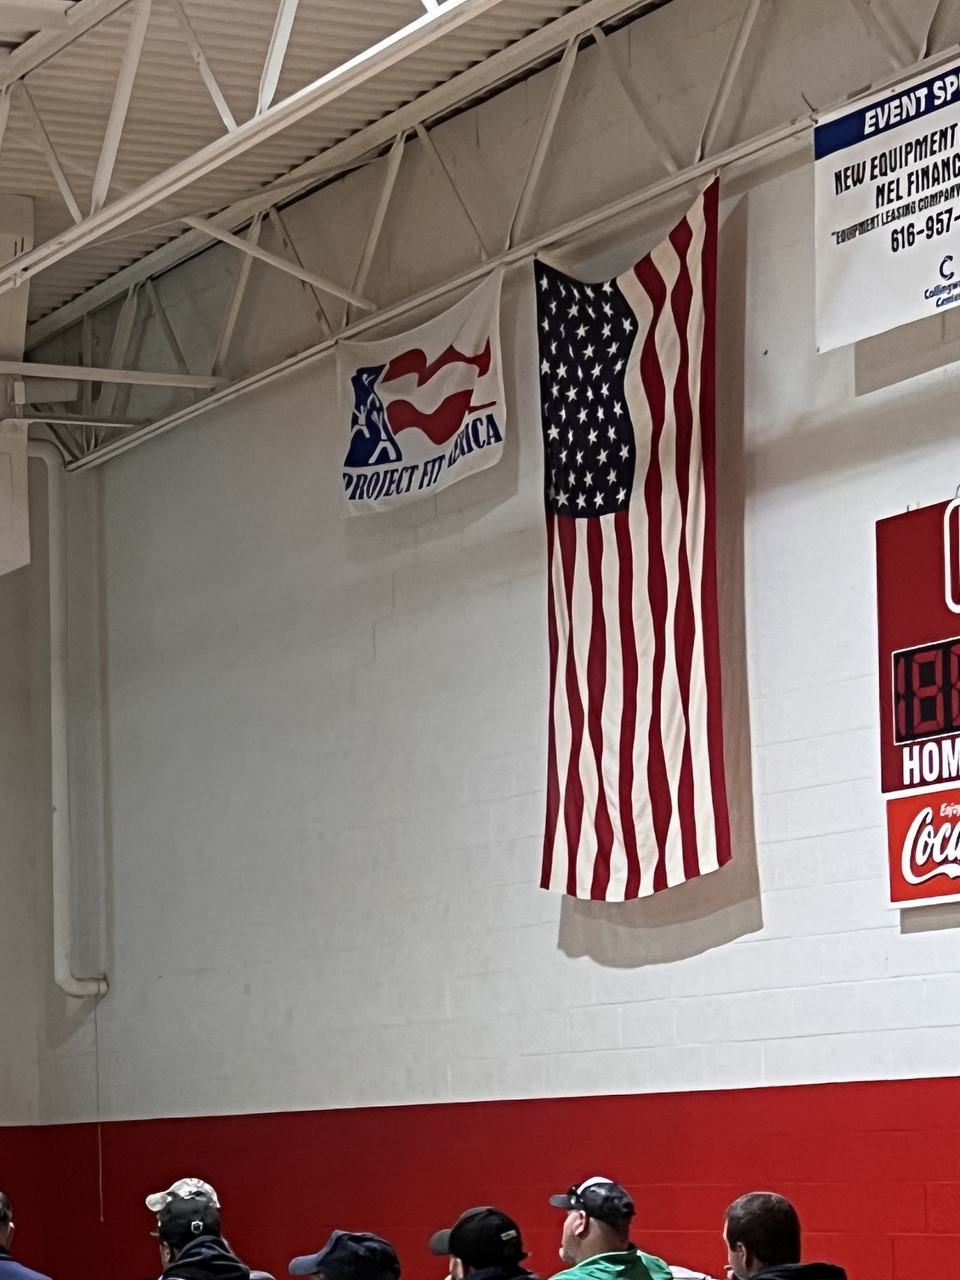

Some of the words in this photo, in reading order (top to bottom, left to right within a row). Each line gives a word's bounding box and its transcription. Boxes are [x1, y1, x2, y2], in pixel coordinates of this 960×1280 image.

[864, 87, 928, 135] EVENT
[933, 73, 960, 106] SP
[834, 160, 867, 195] NEW
[869, 123, 958, 181] EQUIPMENT
[342, 464, 419, 501] PROJECT
[418, 454, 445, 490] FIT
